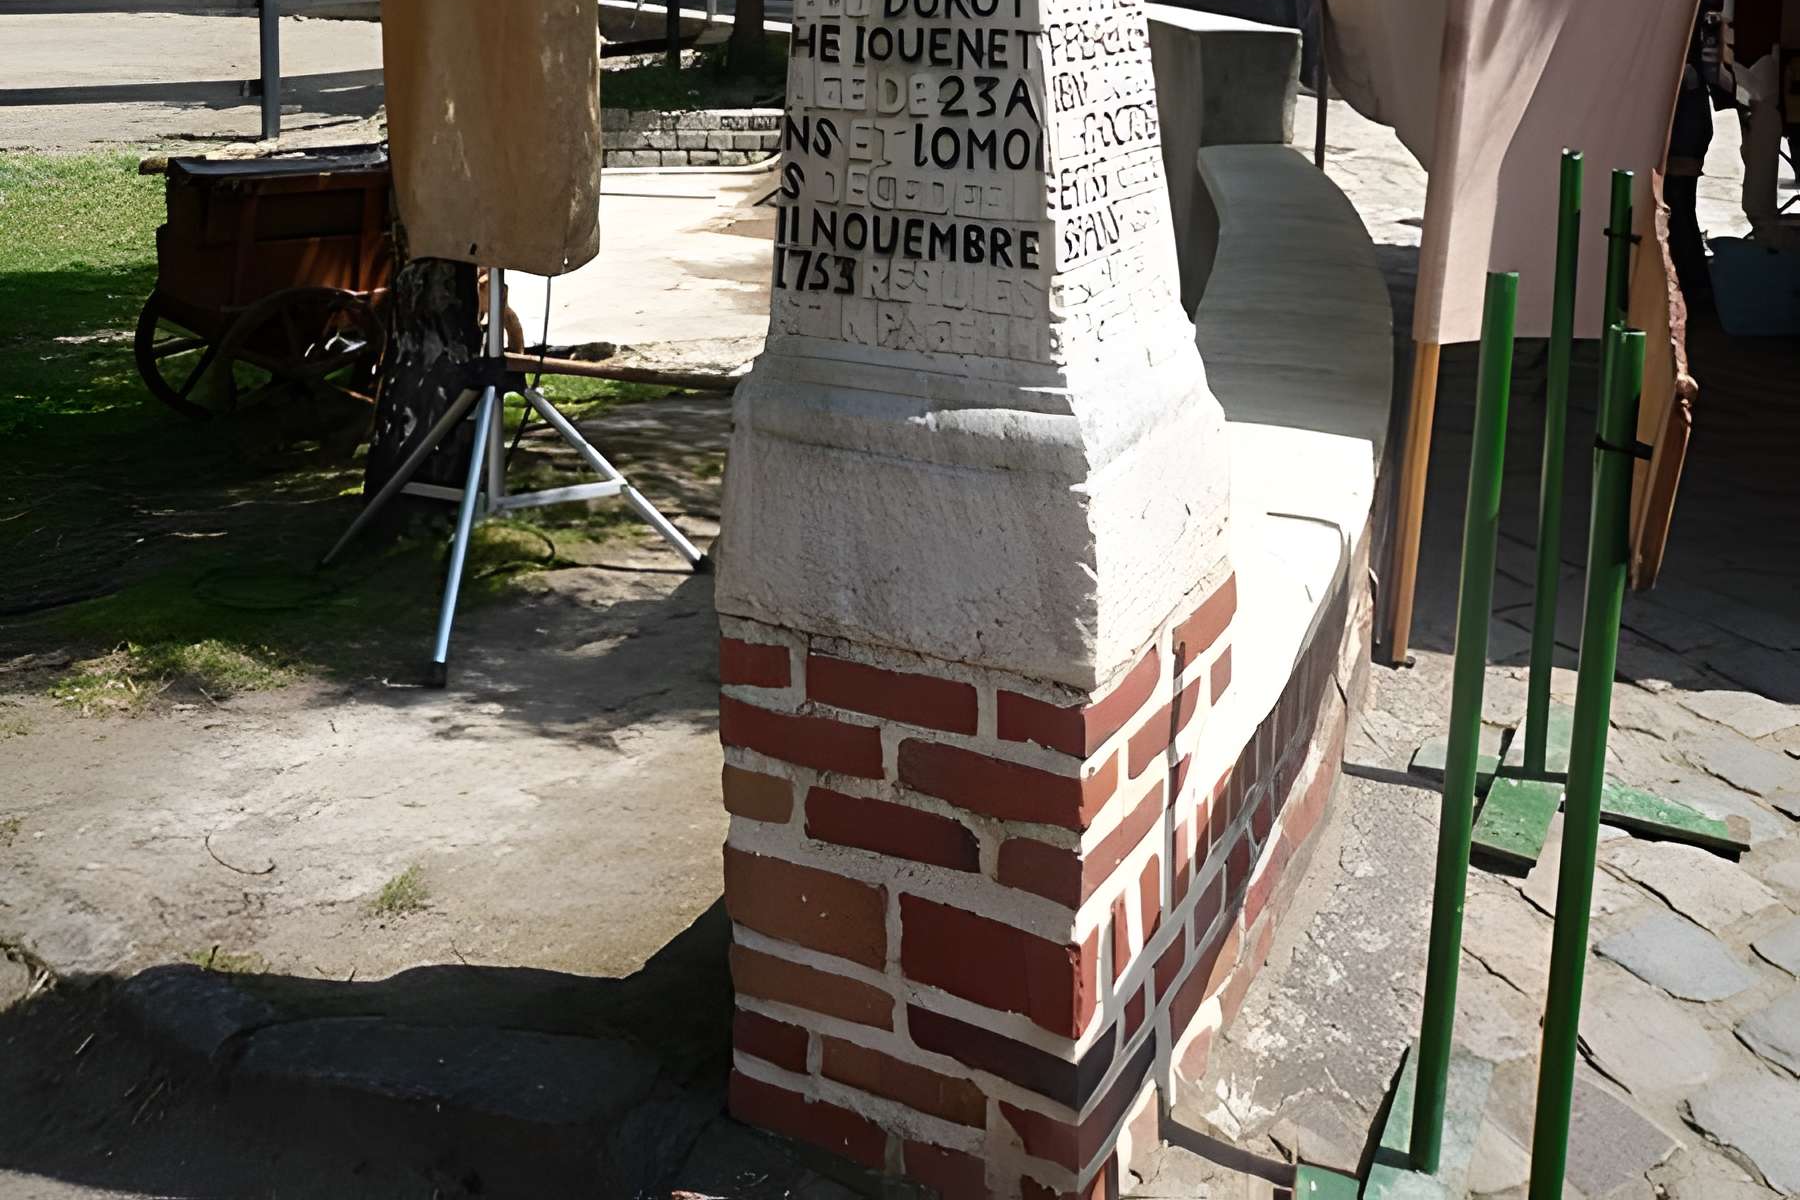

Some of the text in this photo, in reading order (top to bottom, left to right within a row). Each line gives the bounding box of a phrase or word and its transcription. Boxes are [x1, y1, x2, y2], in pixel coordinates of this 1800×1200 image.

[792, 23, 841, 64] HE
[811, 207, 1040, 270] NOUEMBRE
[775, 249, 857, 295] 1753
